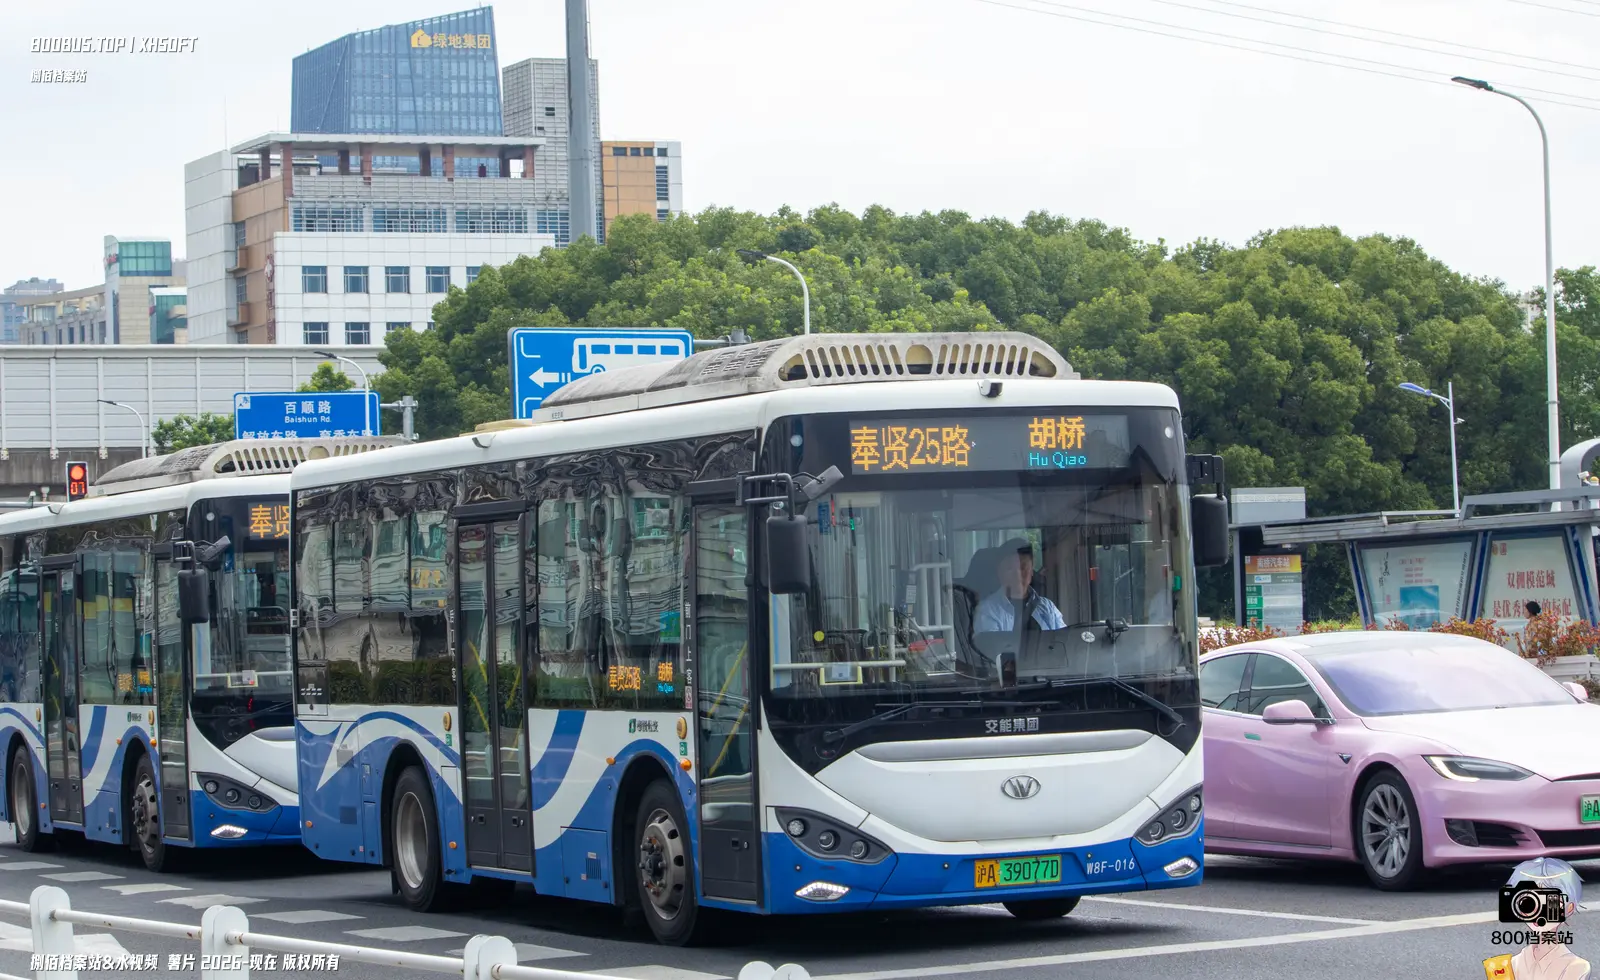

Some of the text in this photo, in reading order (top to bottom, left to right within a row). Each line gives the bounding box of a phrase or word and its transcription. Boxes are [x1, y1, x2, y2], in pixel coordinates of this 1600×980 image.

[433, 33, 491, 49] 绿地集团
[284, 401, 332, 415] 百顺路
[284, 415, 318, 424] Baishun
[851, 416, 1086, 471] 奉贤25路 胡桥
[1029, 451, 1088, 469] Hu Qiao
[71, 481, 85, 495] 07
[1493, 598, 1572, 618] 是优秀的标配
[984, 717, 1040, 734] 交能集团
[1086, 858, 1136, 875] W8F-016
